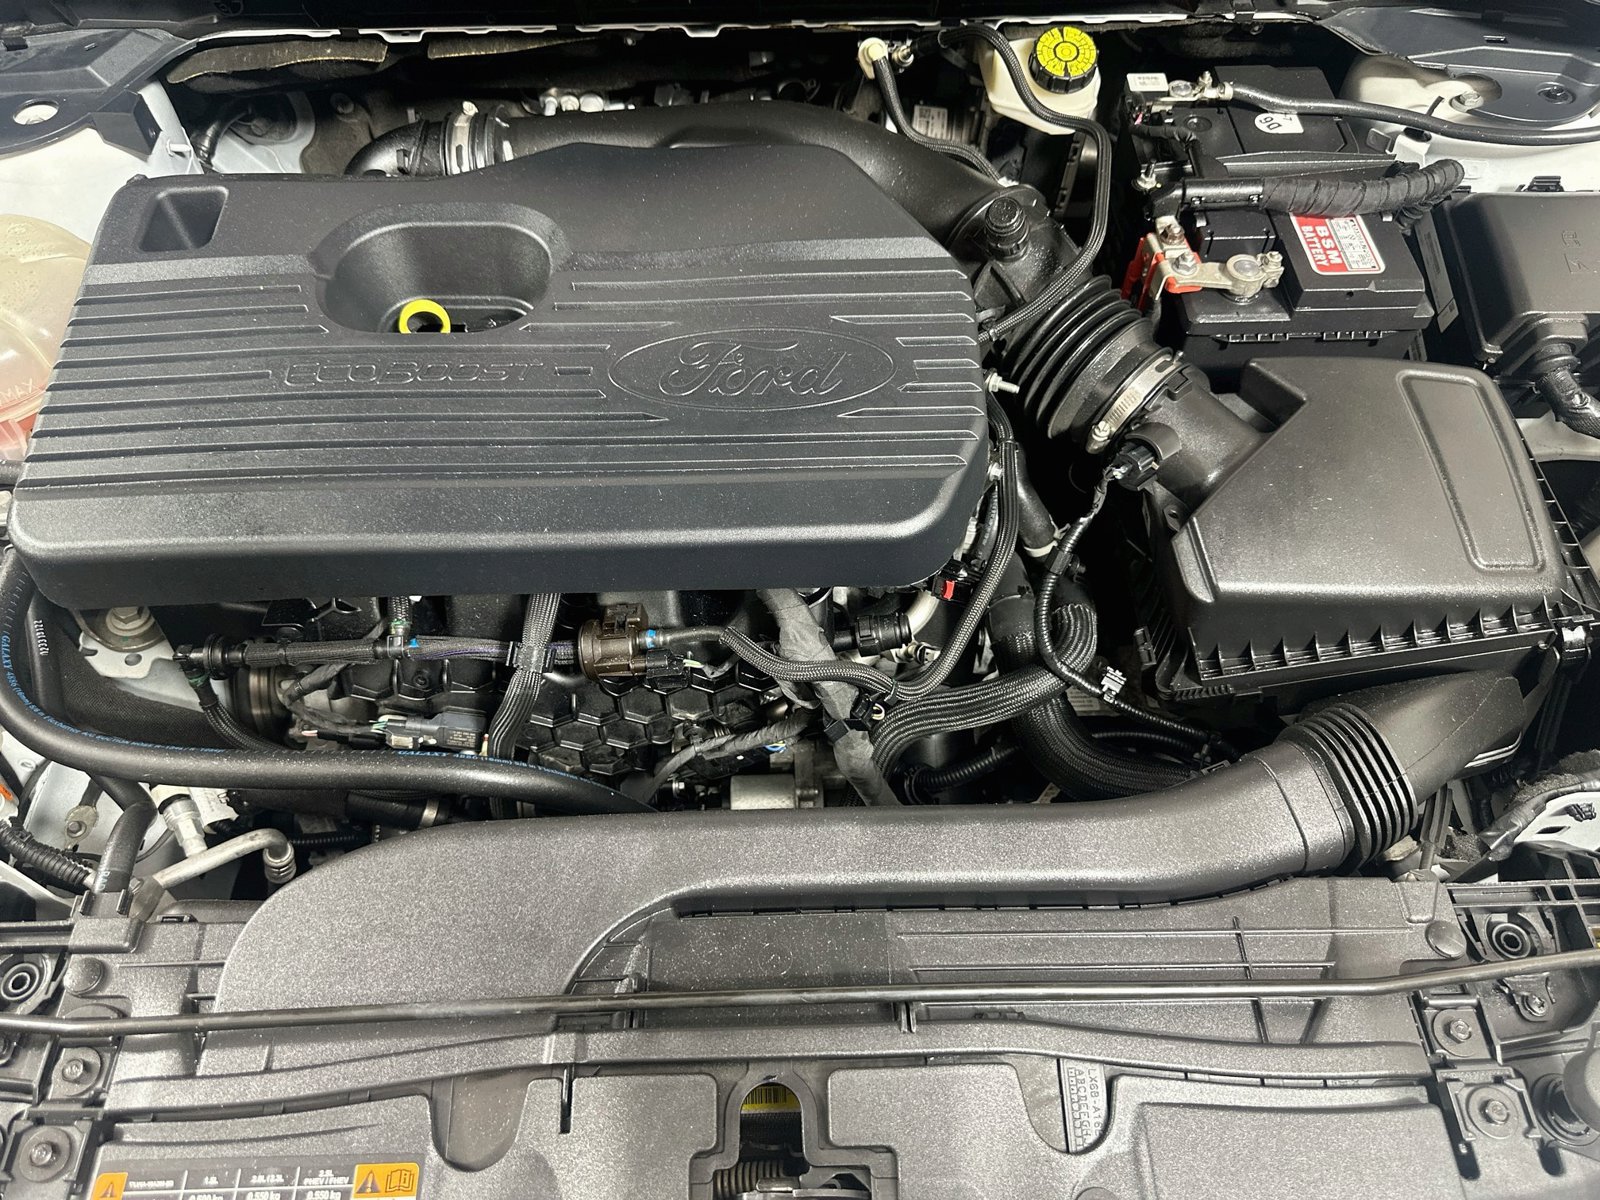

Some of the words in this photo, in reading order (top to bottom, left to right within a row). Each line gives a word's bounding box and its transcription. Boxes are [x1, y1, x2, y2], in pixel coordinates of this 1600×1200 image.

[1301, 225, 1330, 266] BATTERY
[1315, 225, 1343, 264] BSM
[658, 340, 852, 397] Ford
[2, 635, 13, 671] GALAXY
[398, 750, 447, 758] GALAXY
